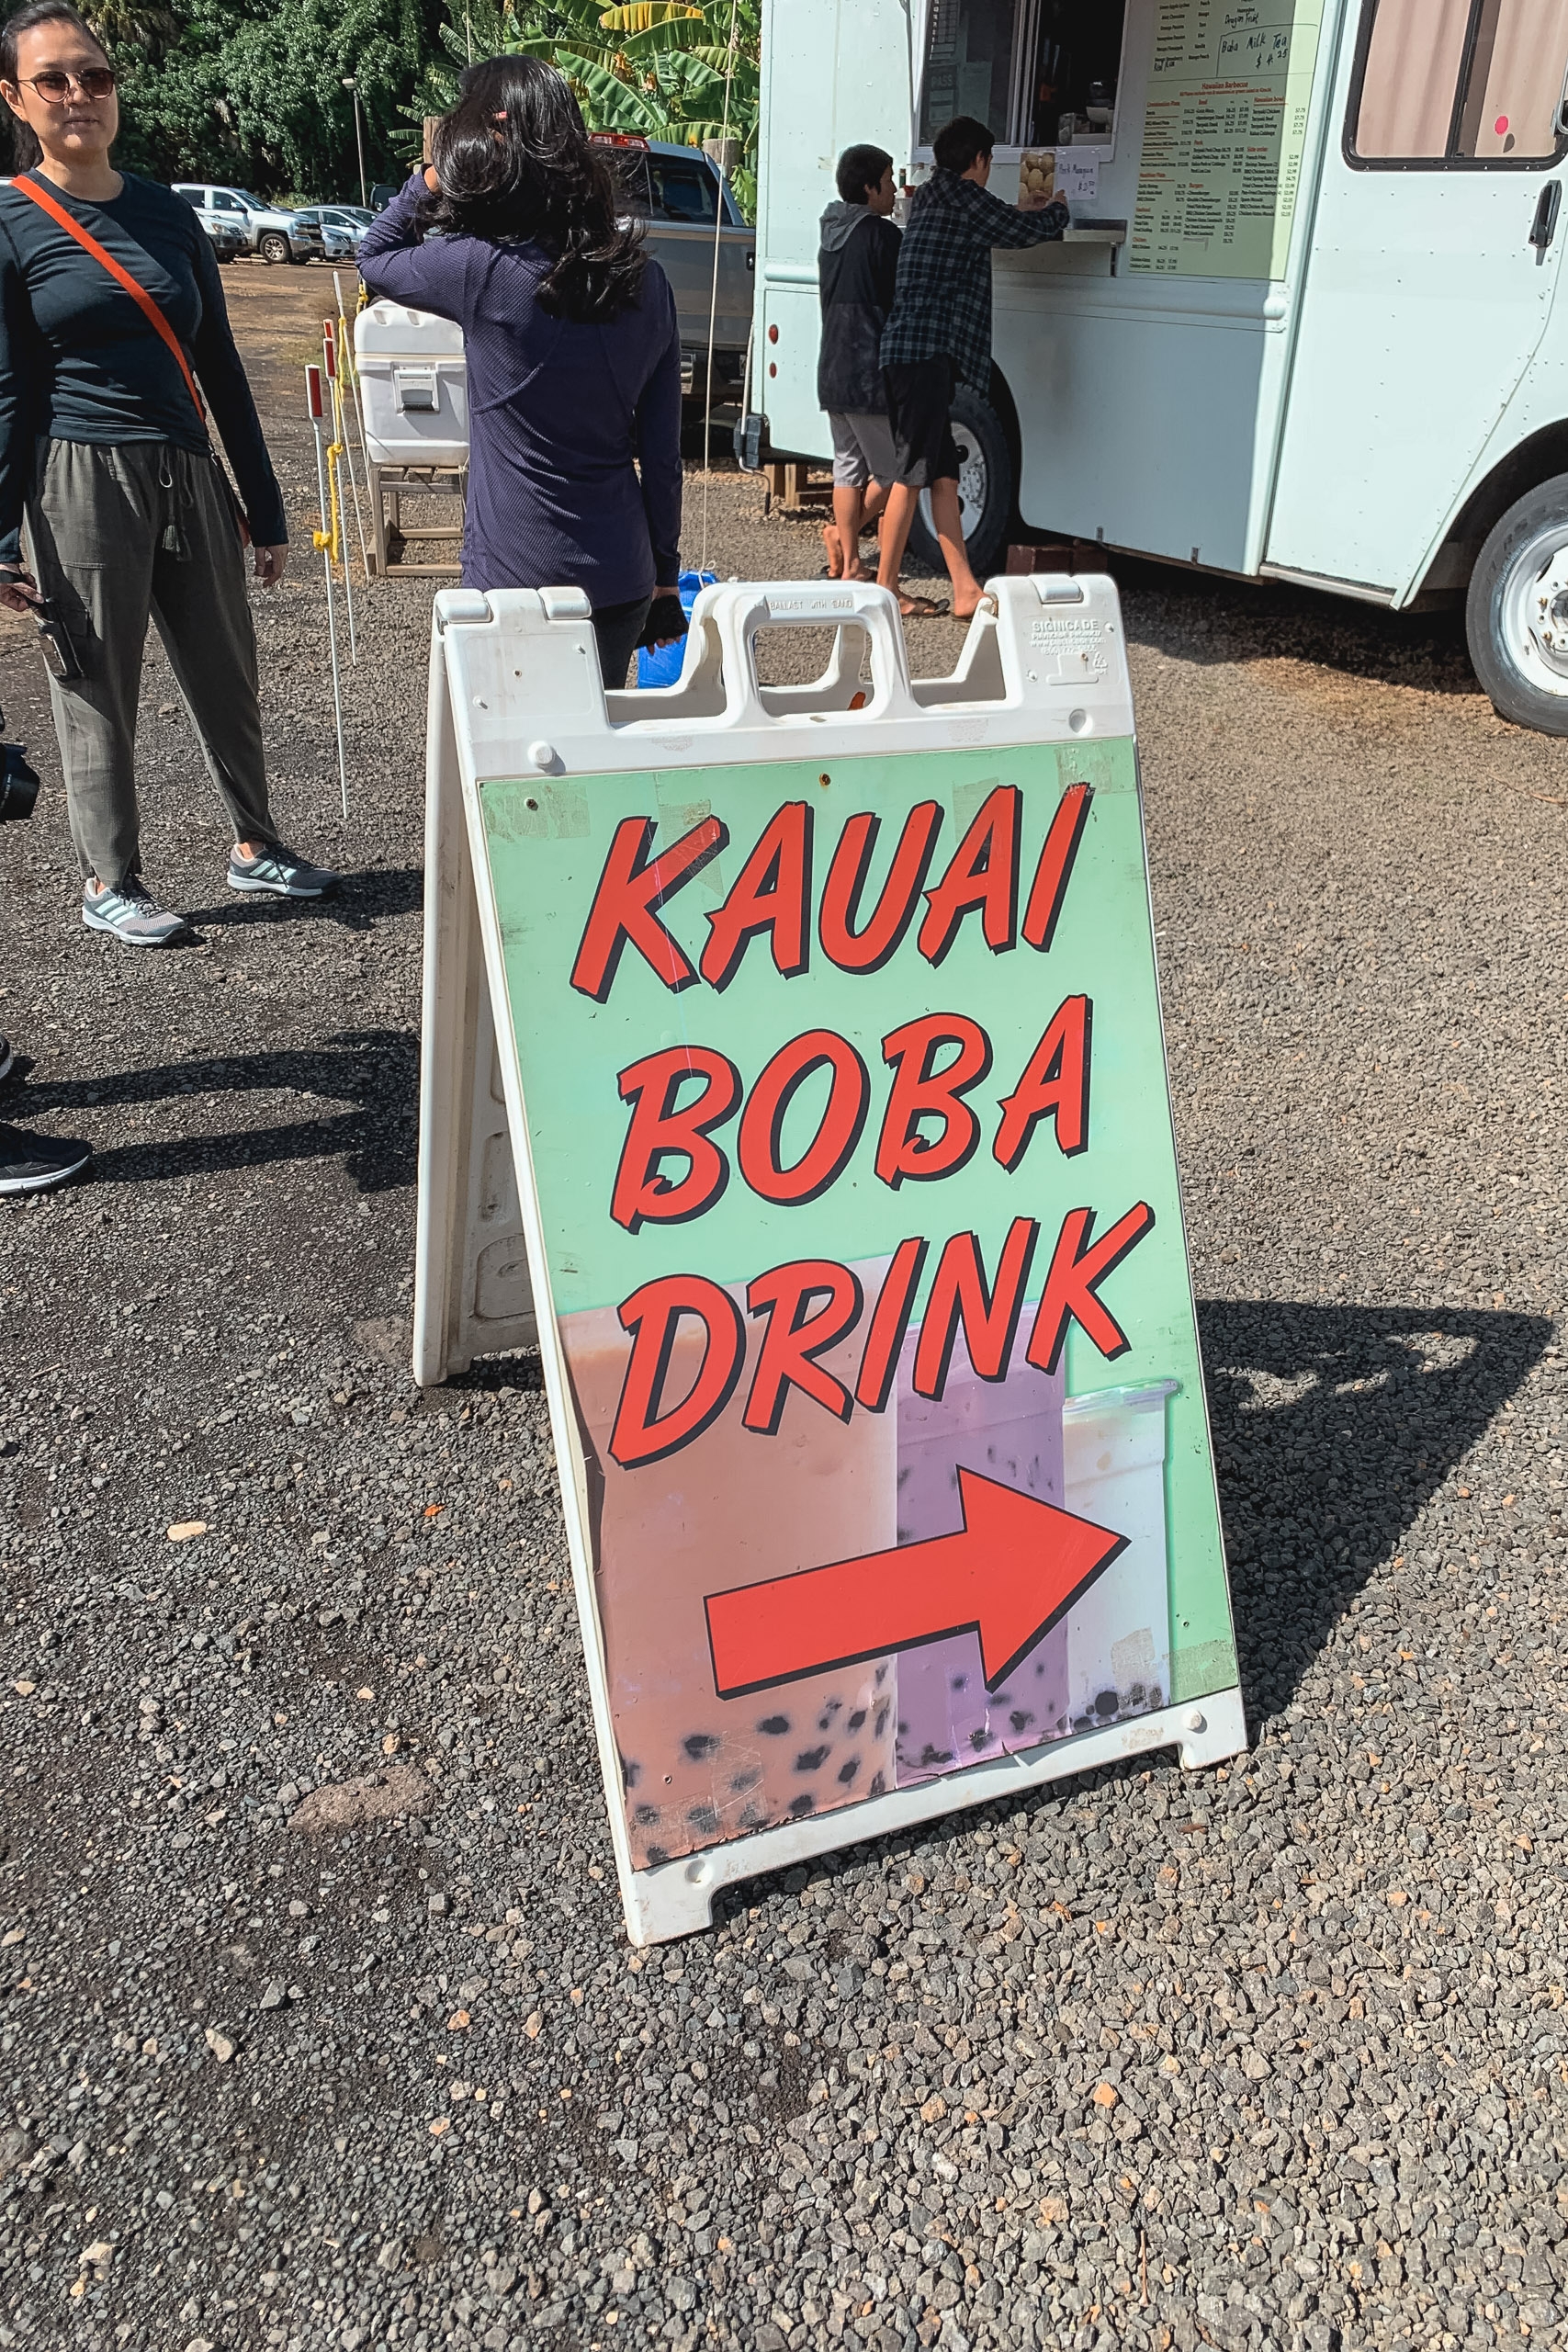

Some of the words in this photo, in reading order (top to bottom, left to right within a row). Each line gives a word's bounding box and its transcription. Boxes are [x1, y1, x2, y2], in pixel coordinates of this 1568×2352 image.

[1247, 32, 1267, 50] Milk
[1273, 32, 1287, 50] Tea
[931, 74, 953, 89] PASS
[770, 600, 803, 611] BALLAST
[1032, 619, 1100, 633] SIGNICADE
[570, 782, 1096, 1003] KAUAI
[610, 993, 1093, 1235] BOBA
[607, 1201, 1156, 1471] DRINK
